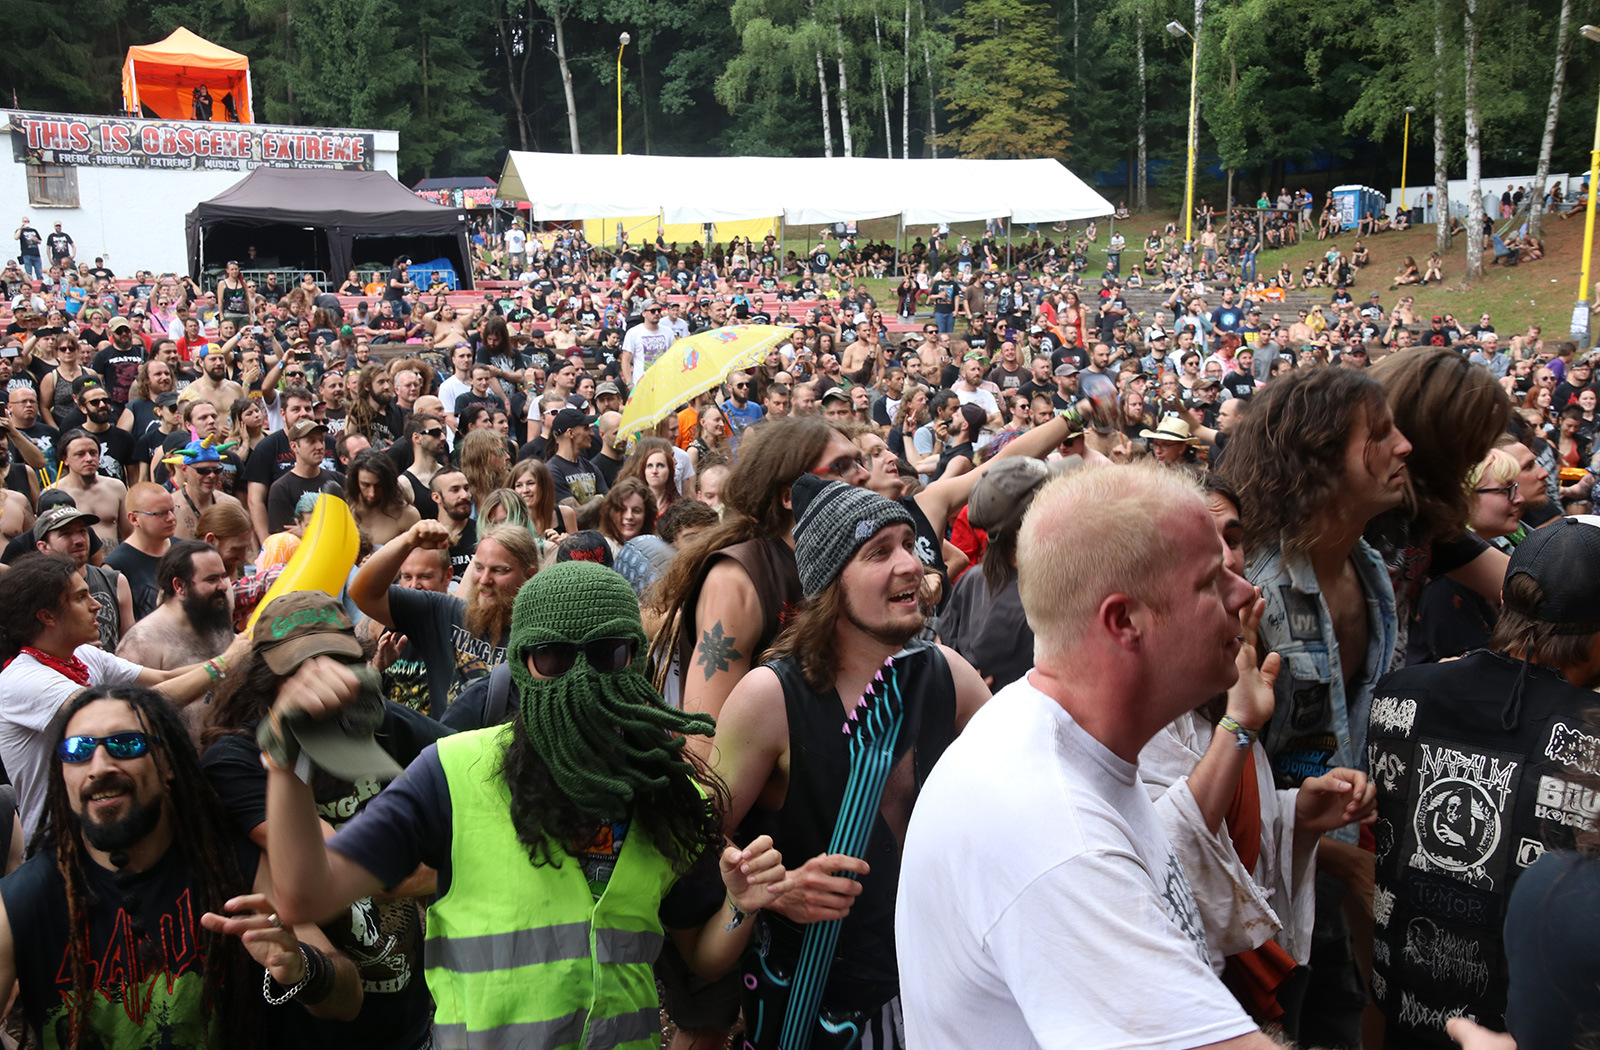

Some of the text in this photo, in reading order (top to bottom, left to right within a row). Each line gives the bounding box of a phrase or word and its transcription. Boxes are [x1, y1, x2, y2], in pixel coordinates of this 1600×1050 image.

[22, 119, 364, 162] THIS IS OBSCENE EXTREME
[150, 157, 191, 168] EXTREME
[205, 159, 239, 170] MUSICK
[1418, 744, 1518, 812] NAPALM
